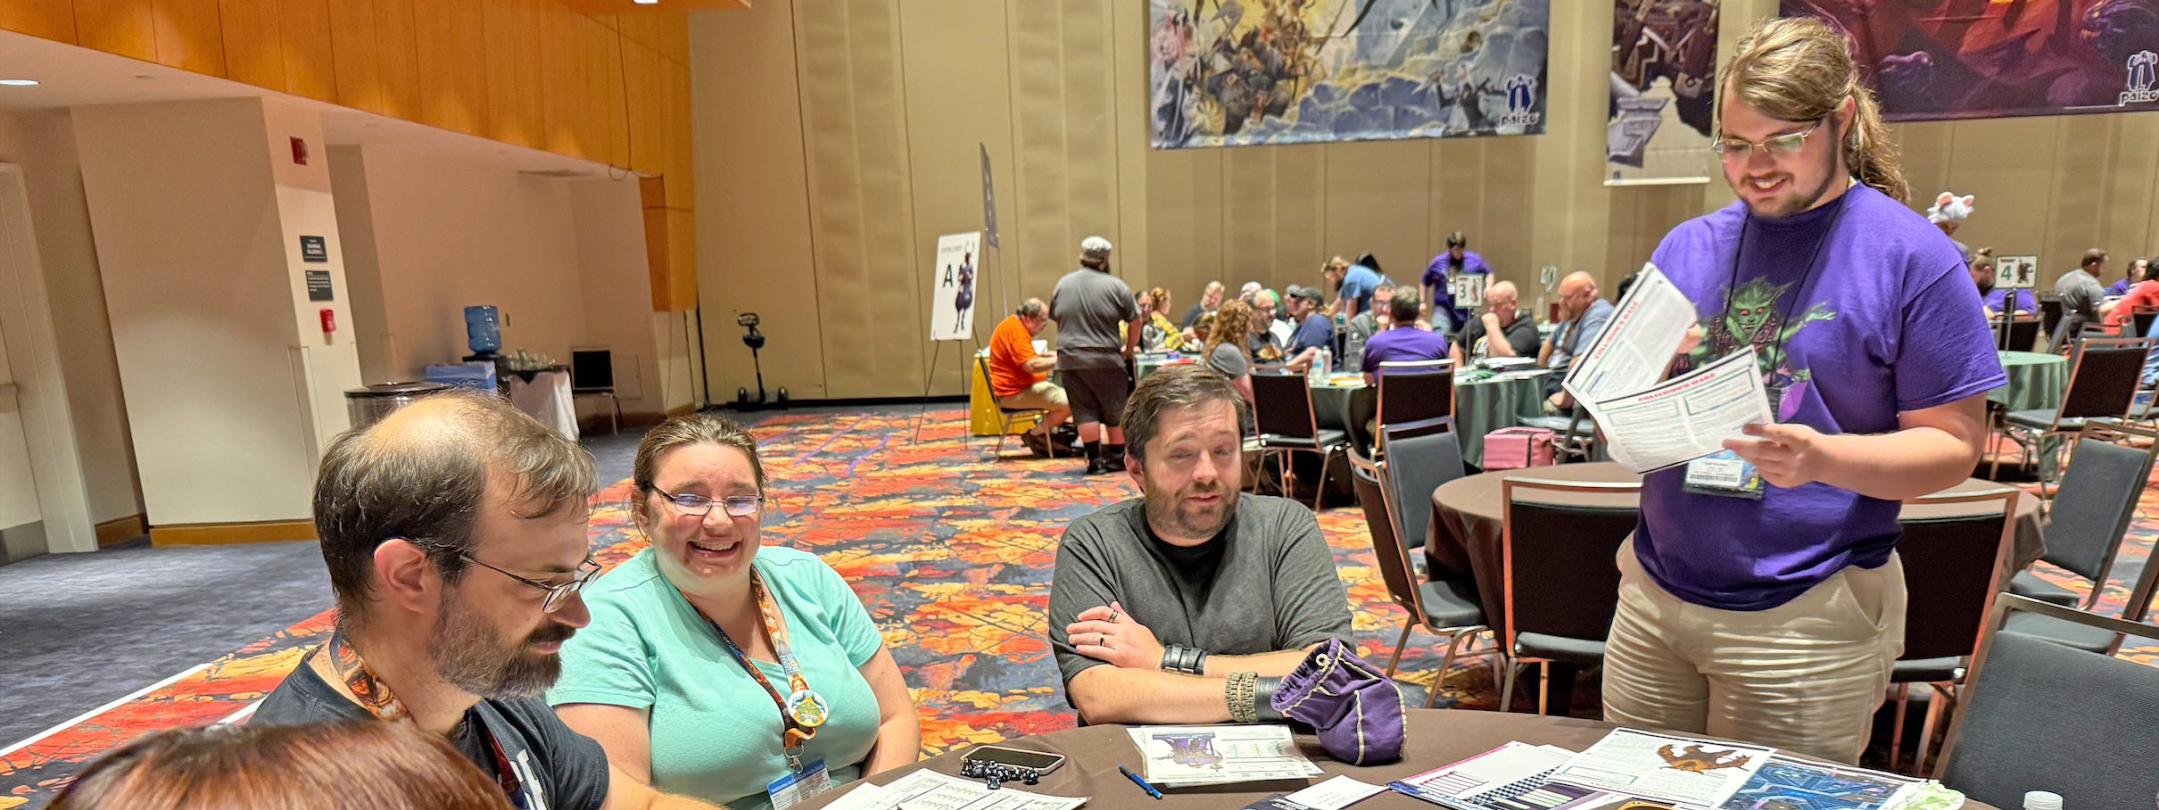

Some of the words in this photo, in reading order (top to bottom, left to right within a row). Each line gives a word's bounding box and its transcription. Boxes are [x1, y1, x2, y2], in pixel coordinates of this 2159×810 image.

[2121, 89, 2158, 105] paizo
[1500, 113, 1537, 127] paizo
[943, 264, 953, 288] A
[2001, 264, 2012, 281] 4
[1458, 284, 1466, 299] 3
